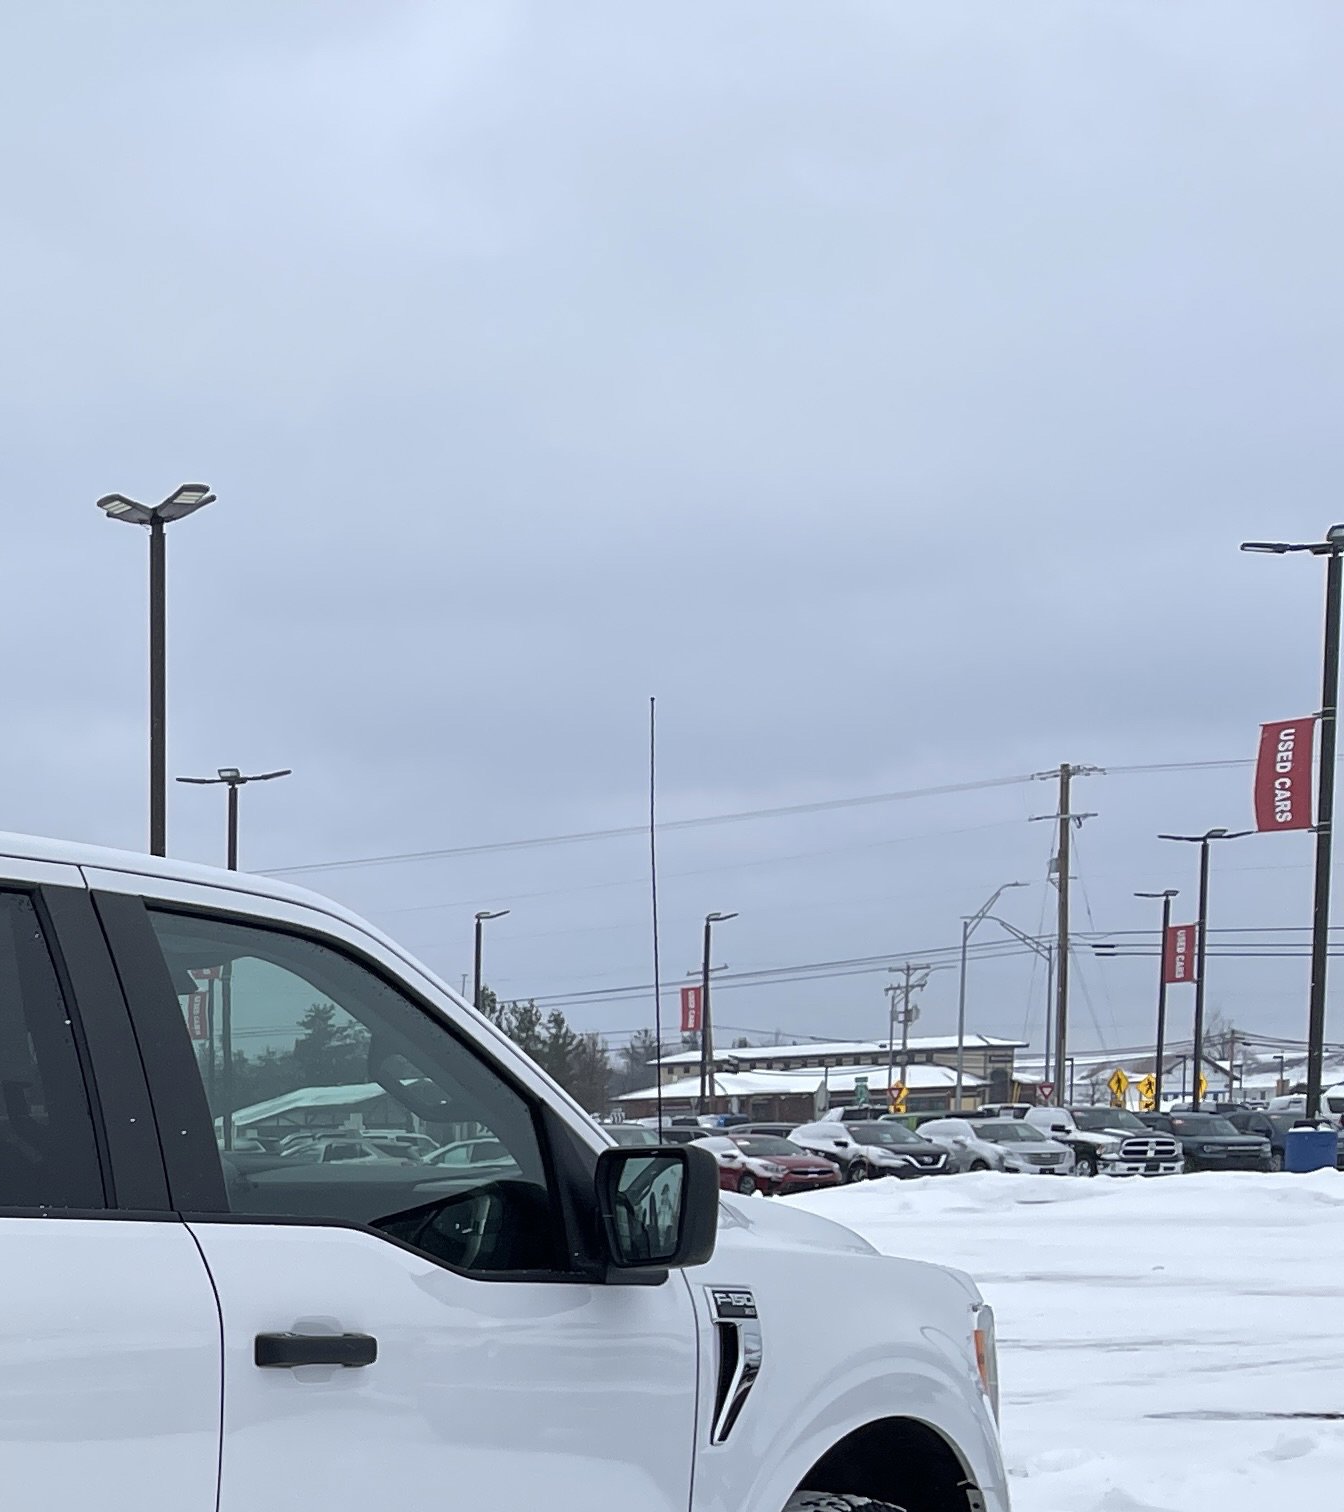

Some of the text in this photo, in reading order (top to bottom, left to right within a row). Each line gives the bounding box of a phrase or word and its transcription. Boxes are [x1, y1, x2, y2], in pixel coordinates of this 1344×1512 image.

[1274, 728, 1296, 823] USED CARS
[714, 1292, 755, 1306] F-150
